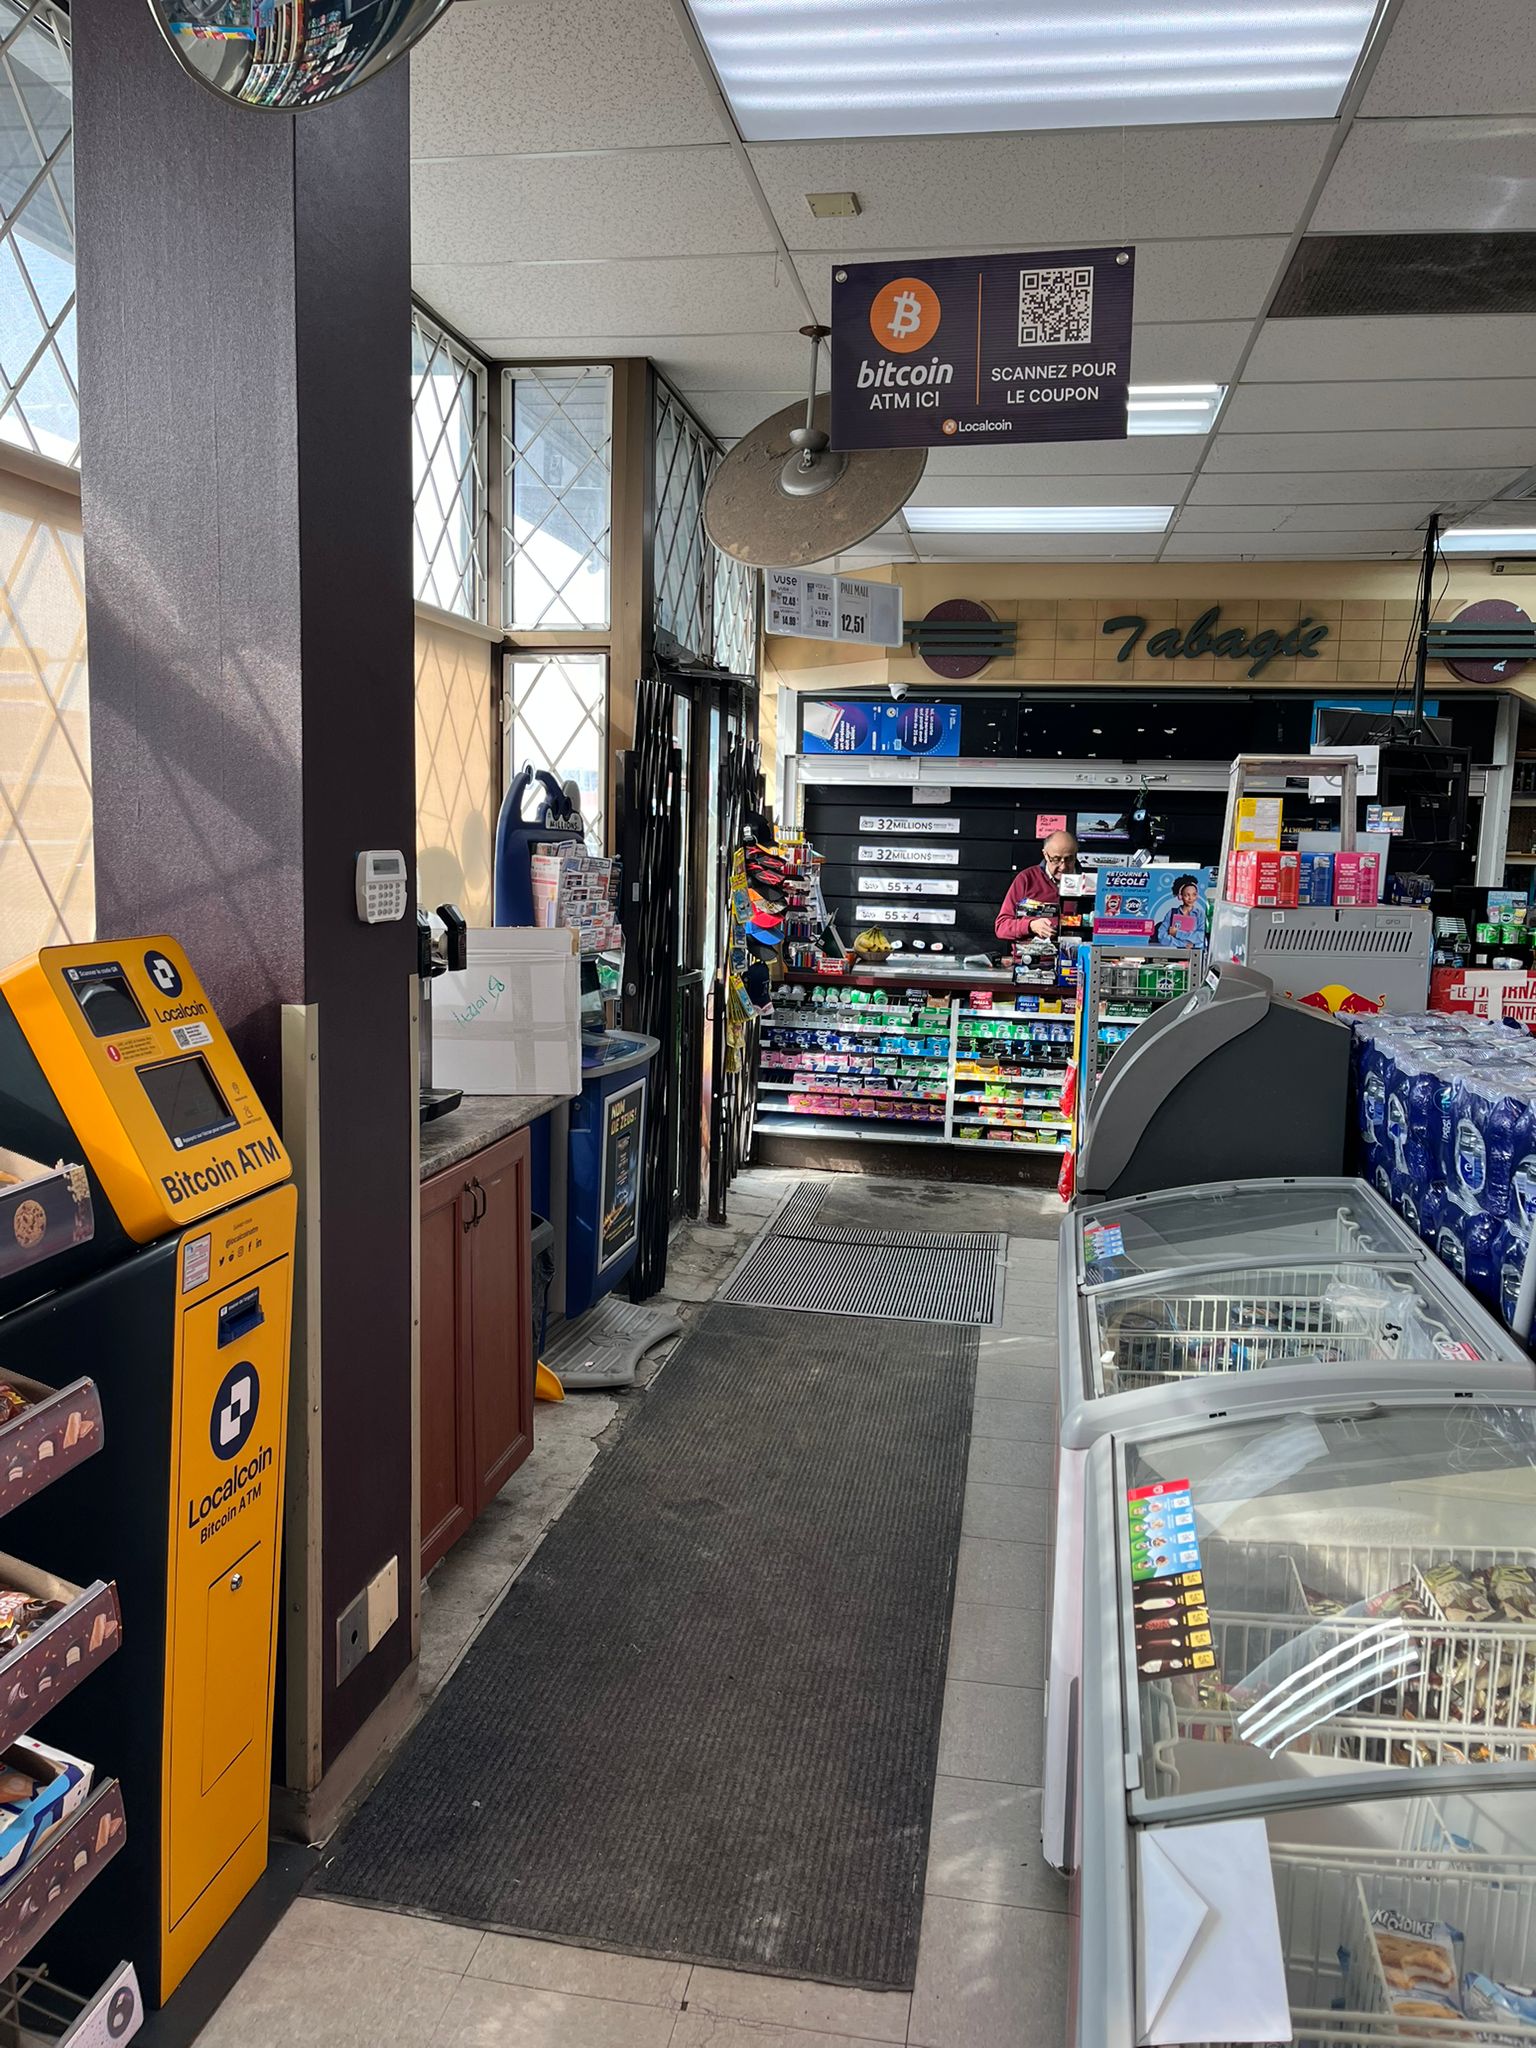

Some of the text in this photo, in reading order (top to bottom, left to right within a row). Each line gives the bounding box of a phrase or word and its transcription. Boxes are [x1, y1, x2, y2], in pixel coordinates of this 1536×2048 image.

[857, 356, 954, 389] bitcoin
[991, 362, 1117, 382] SCANNEZ POUR
[869, 391, 940, 410] ATM ICI
[1007, 386, 1099, 404] LE COUPON
[958, 419, 1012, 433] Localcoin
[841, 582, 854, 595] PALL
[854, 584, 869, 598] MALL
[1103, 606, 1329, 680] Tabagie
[877, 818, 893, 831] 32
[876, 849, 892, 861] 32
[887, 882, 901, 892] 55
[915, 882, 923, 892] 4
[1105, 876, 1146, 886] L'ÉCOLE
[884, 911, 899, 920] 55
[912, 912, 920, 921] 4
[1457, 986, 1468, 998] LE
[154, 1000, 208, 1023] Localcoin
[161, 1135, 282, 1205] Bitcoin ATM
[188, 1445, 273, 1529] Localcoin
[200, 1482, 262, 1545] Bitcoin ATM
